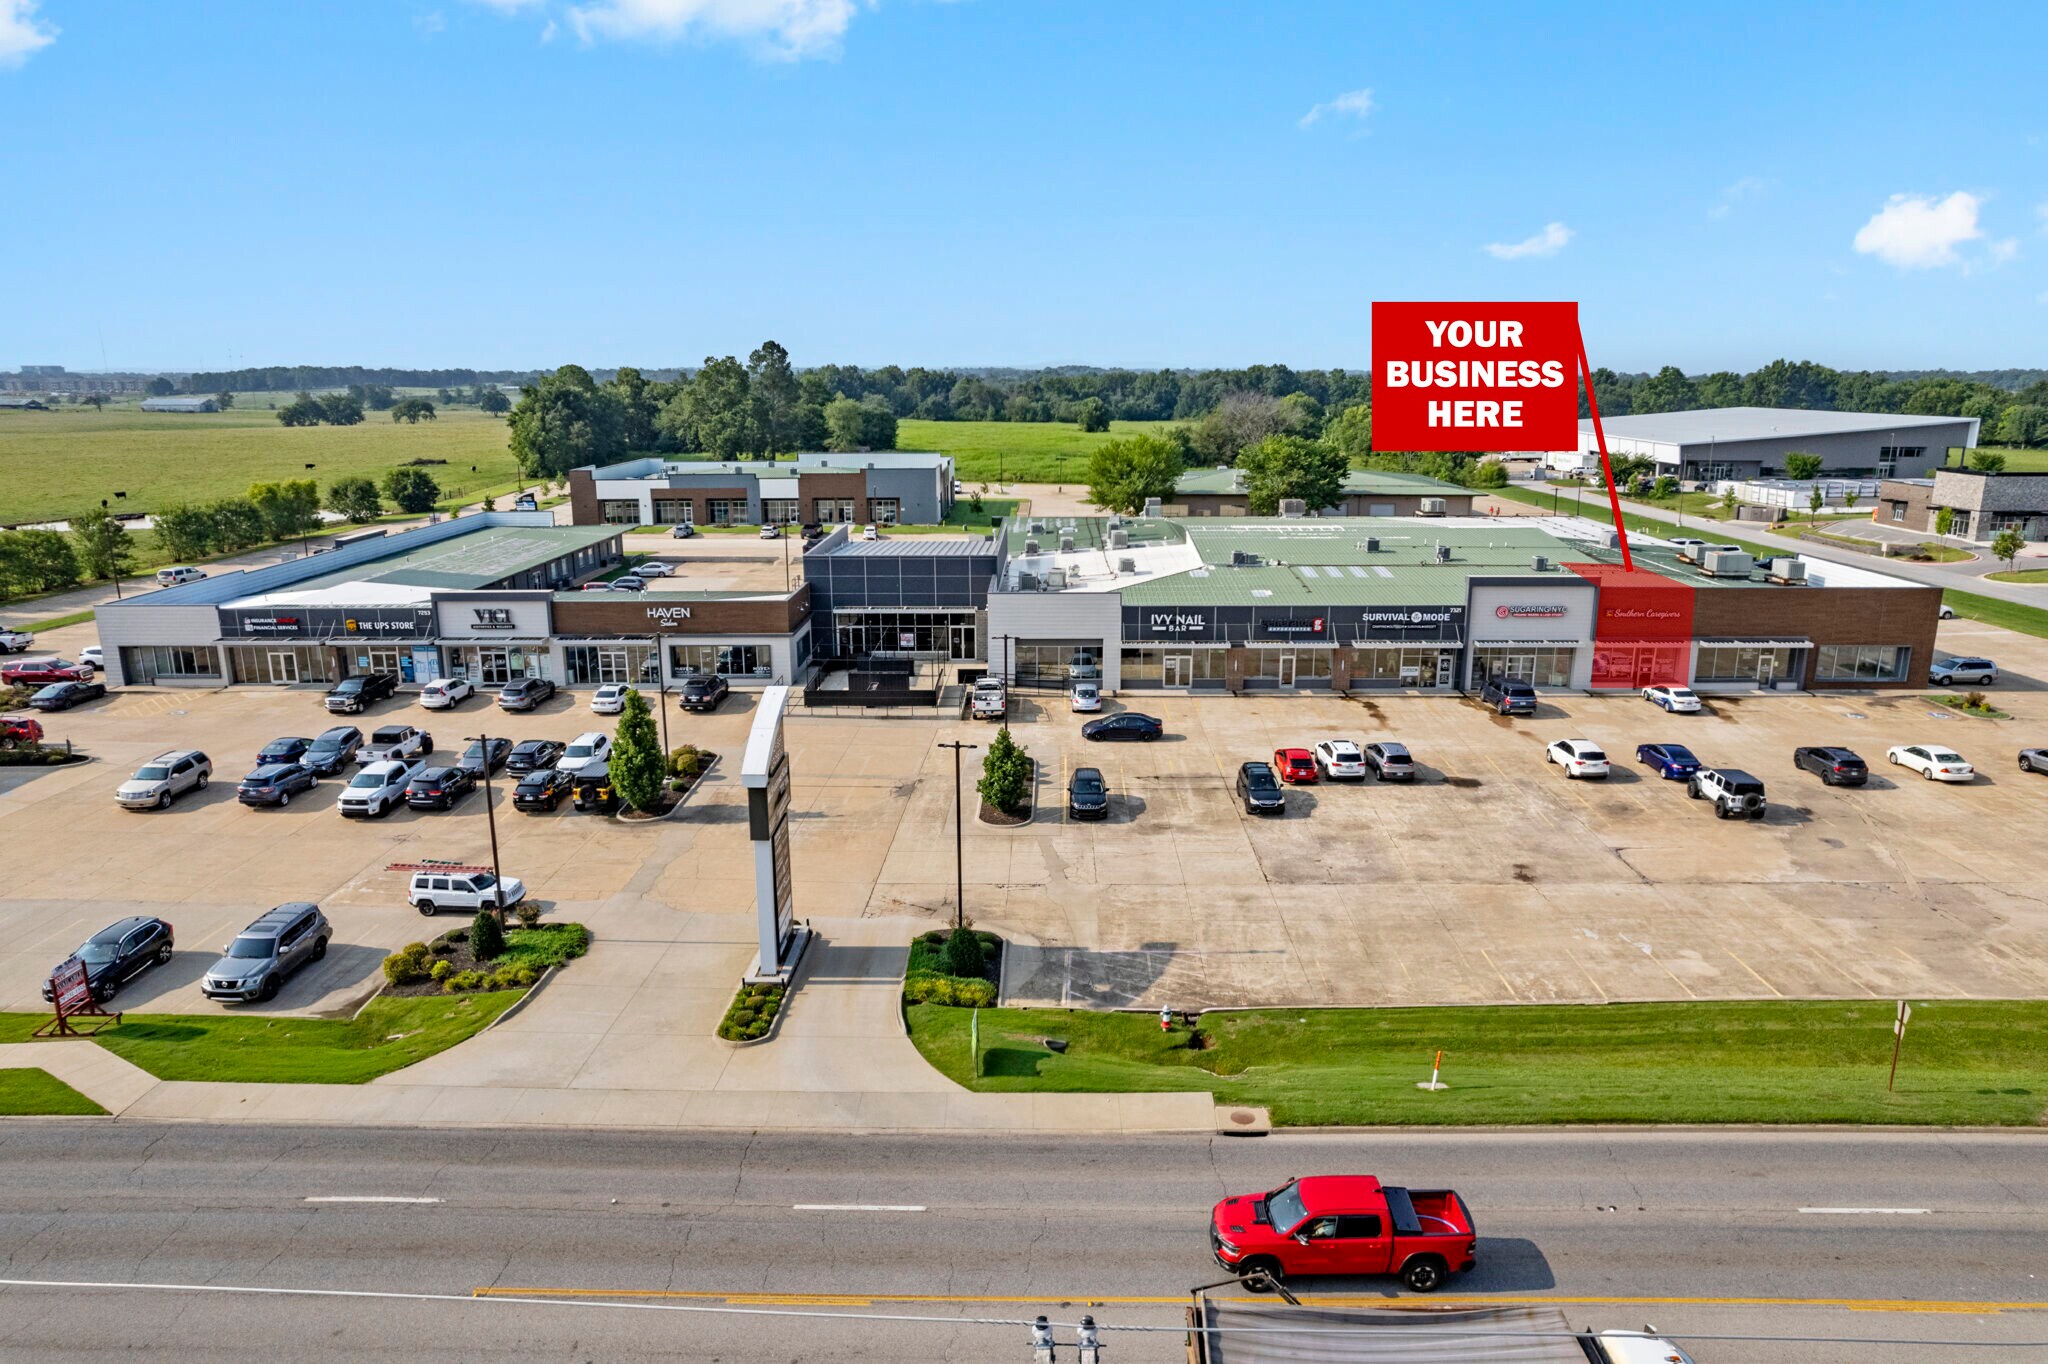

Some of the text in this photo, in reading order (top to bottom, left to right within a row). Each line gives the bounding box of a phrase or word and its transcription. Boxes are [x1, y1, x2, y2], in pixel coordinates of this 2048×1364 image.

[474, 608, 511, 623] VICI
[646, 607, 691, 618] HAVEN
[1362, 613, 1450, 621] SURVIVAL MODE
[1614, 608, 1681, 619] Southern Caregivers
[660, 618, 678, 627] Salon
[1151, 614, 1205, 625] IVY NAIL
[358, 621, 415, 630] THE UPS STORE
